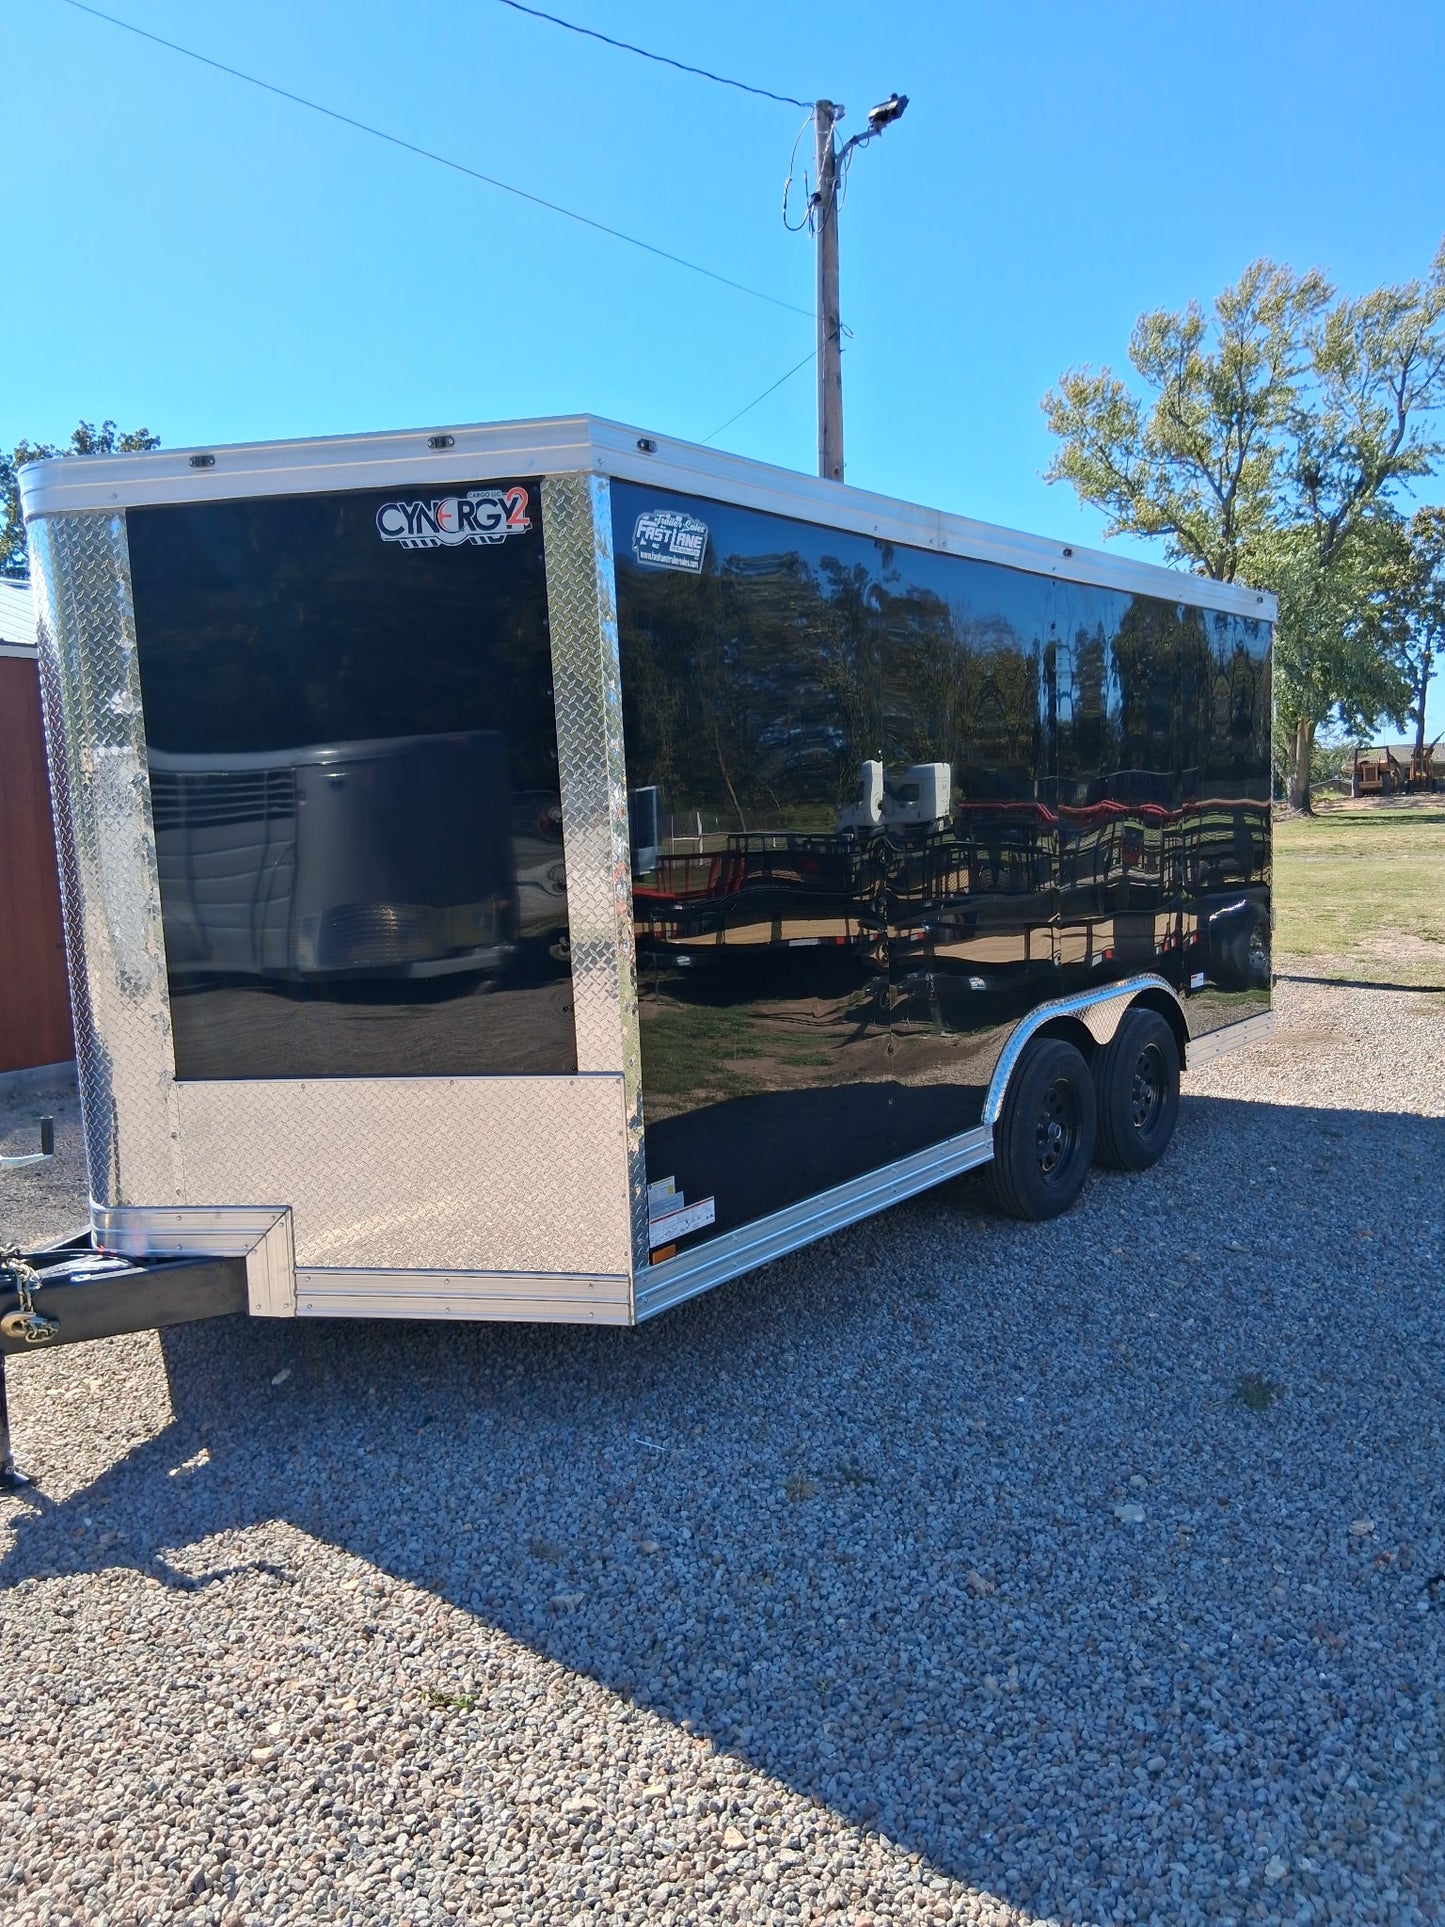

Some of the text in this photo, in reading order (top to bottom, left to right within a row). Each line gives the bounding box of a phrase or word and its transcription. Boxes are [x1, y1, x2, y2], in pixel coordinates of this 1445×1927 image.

[468, 491, 490, 499] CARGO
[636, 519, 672, 543] FAST
[683, 520, 706, 533] Sales
